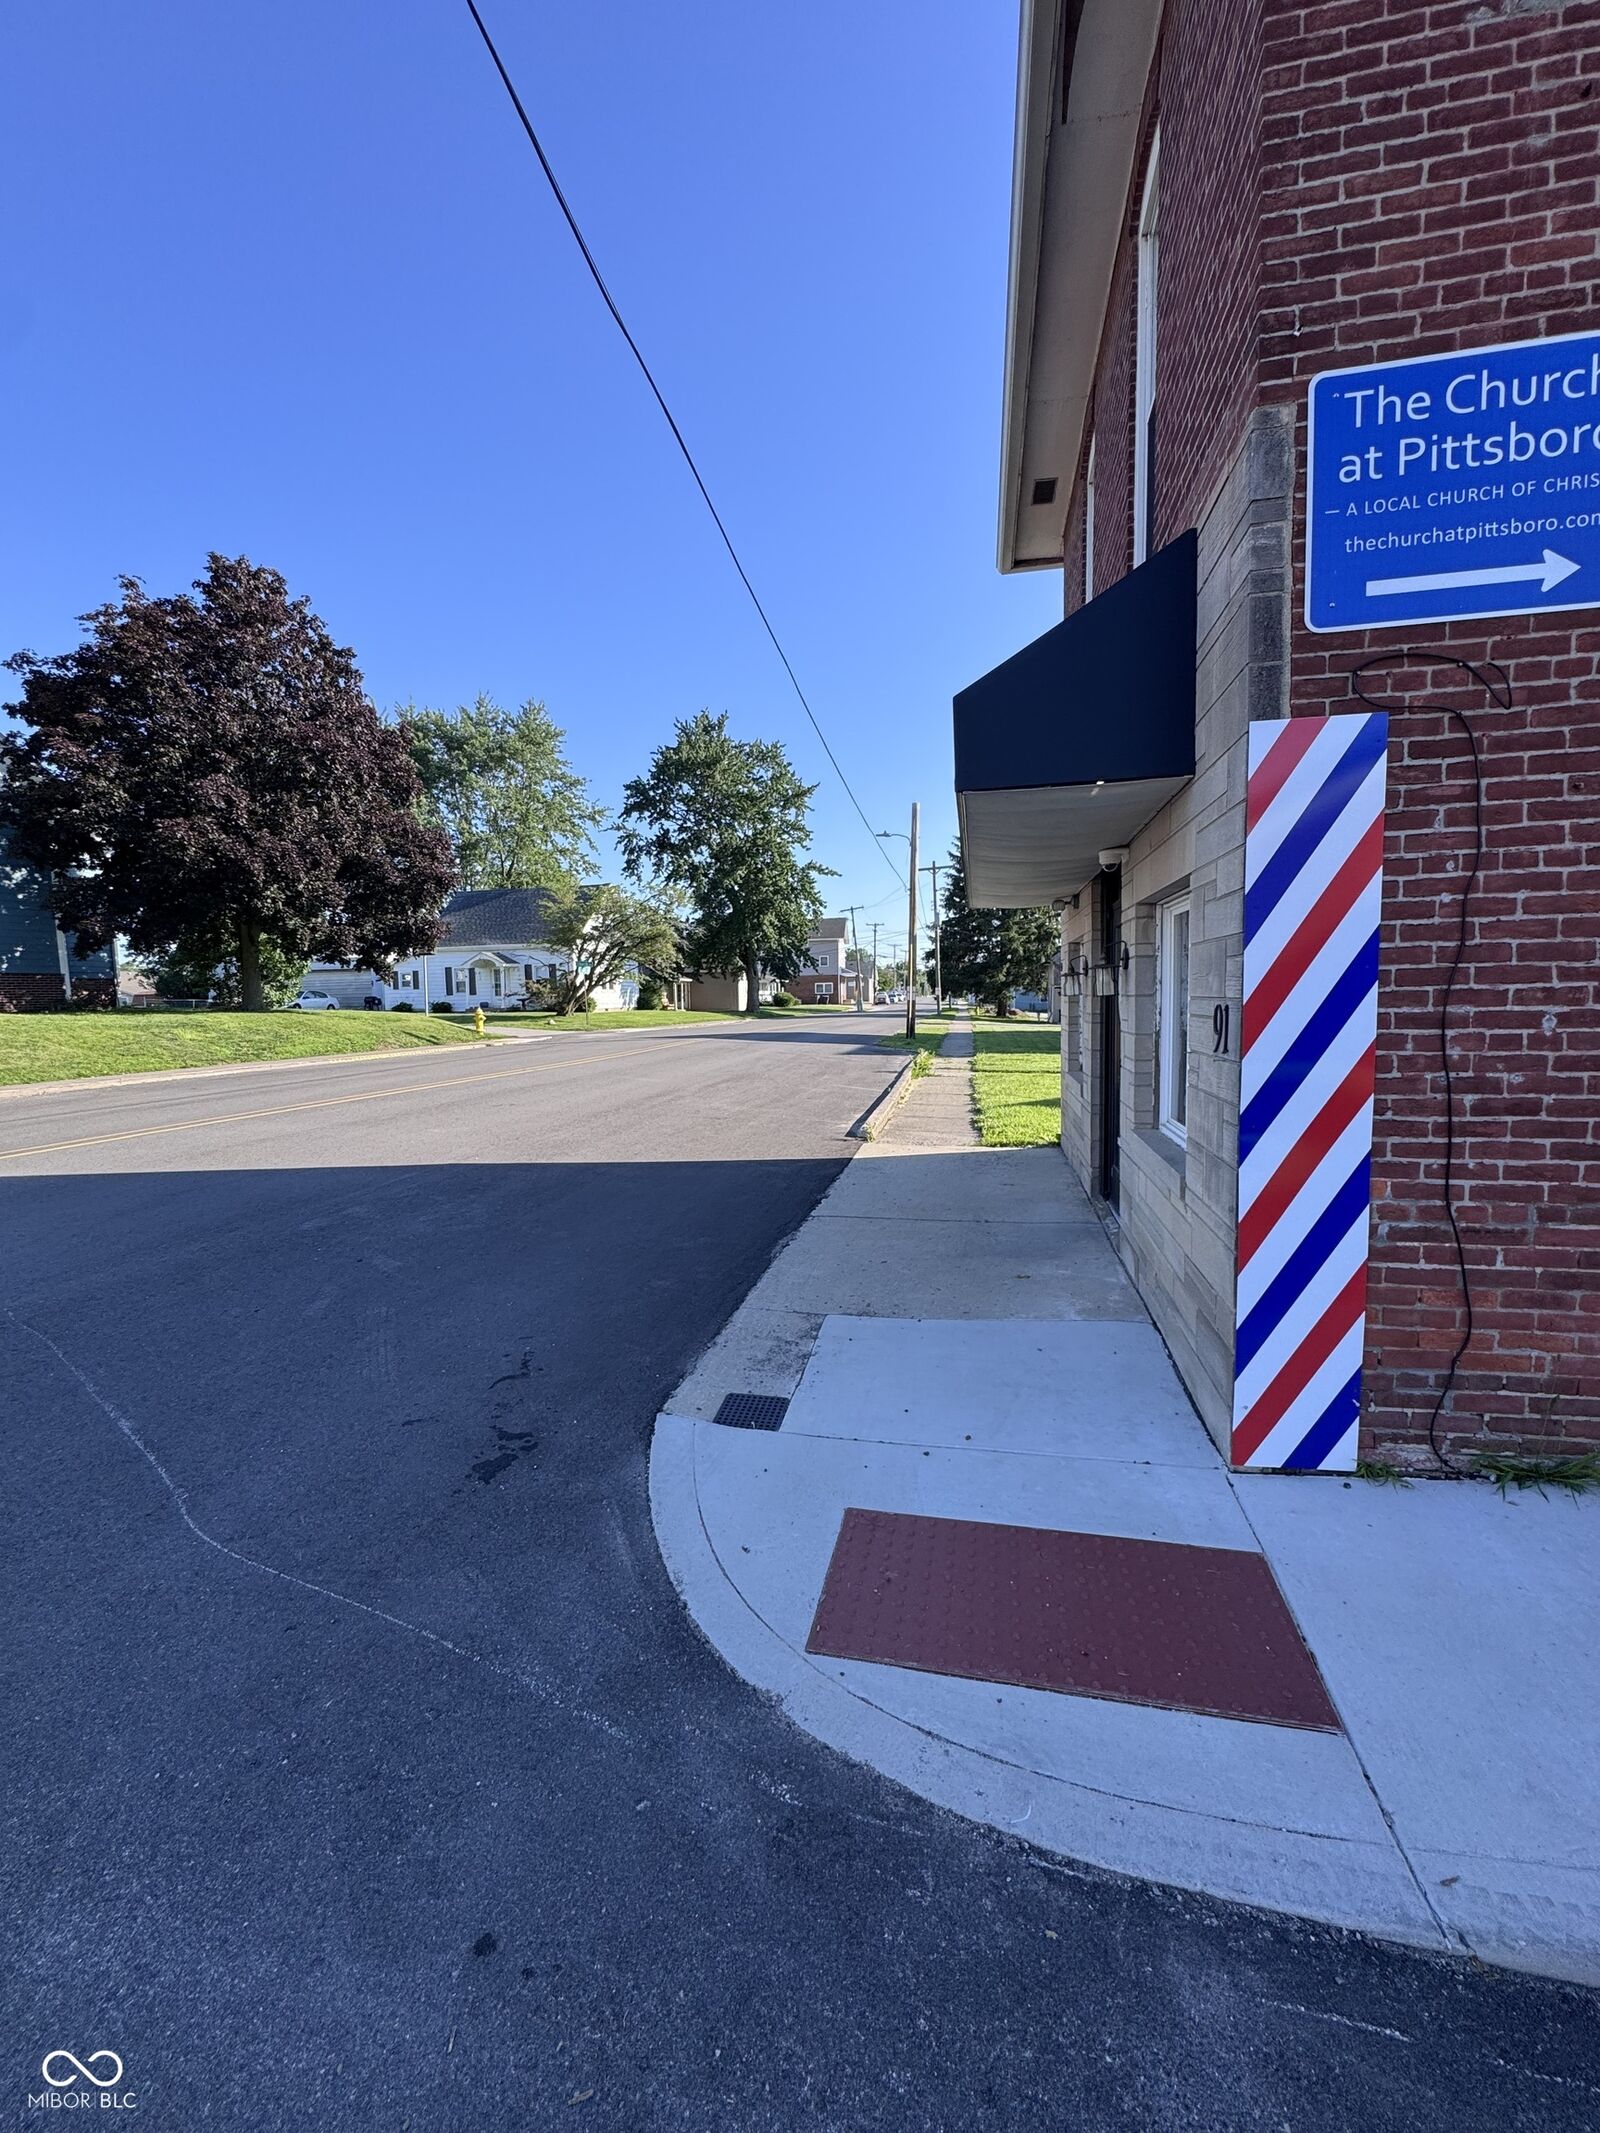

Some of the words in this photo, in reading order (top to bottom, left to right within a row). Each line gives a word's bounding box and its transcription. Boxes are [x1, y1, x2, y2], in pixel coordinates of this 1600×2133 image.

[1343, 384, 1431, 428] The
[1338, 446, 1383, 483] at
[1346, 502, 1358, 517] A
[1364, 495, 1421, 515] LOCAL
[1427, 484, 1504, 507] CHURCH
[1511, 480, 1537, 497] OF
[1543, 472, 1600, 493] CHRIS
[1212, 1003, 1230, 1054] 91
